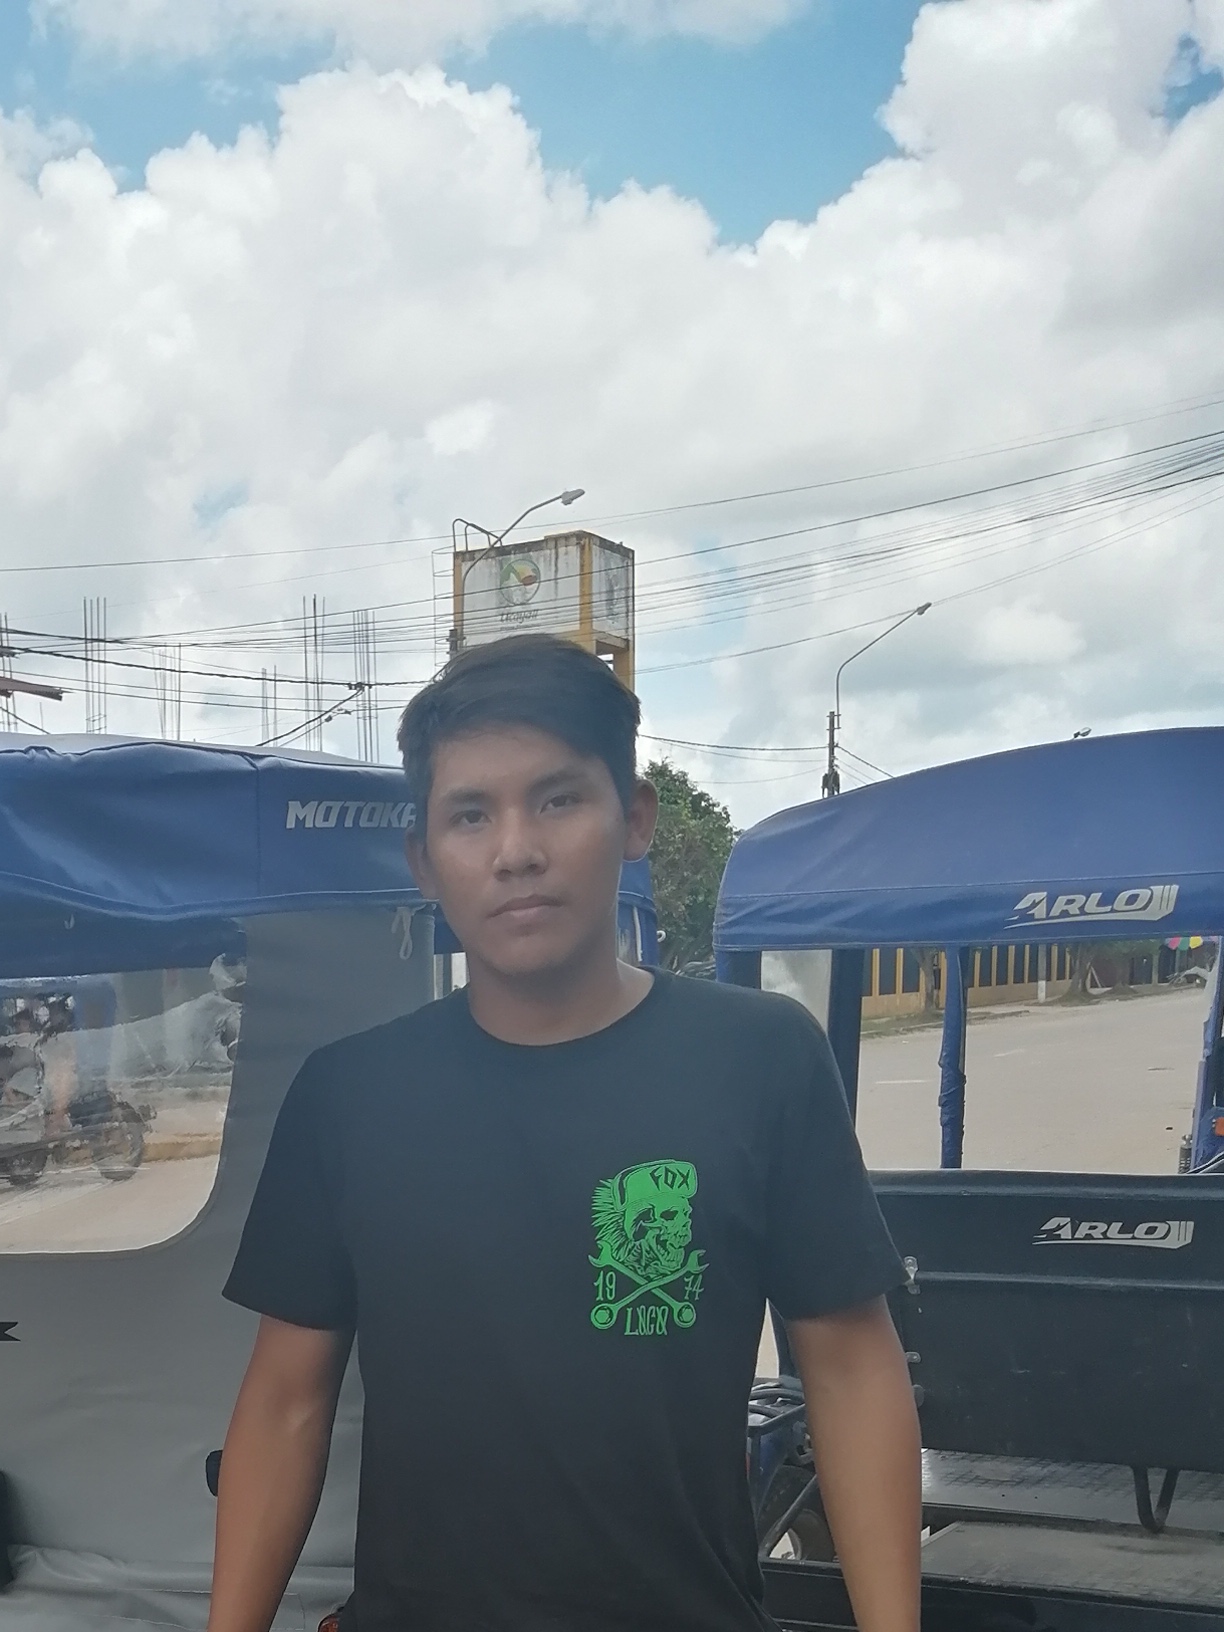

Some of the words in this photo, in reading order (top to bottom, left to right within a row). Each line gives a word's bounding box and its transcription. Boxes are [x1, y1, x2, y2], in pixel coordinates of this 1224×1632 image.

[286, 801, 417, 829] MOTOKA
[1008, 886, 1162, 922] ARLO
[649, 1166, 691, 1191] FOX
[1036, 1217, 1178, 1242] ARLO
[593, 1270, 617, 1301] 19
[684, 1274, 705, 1301] 74
